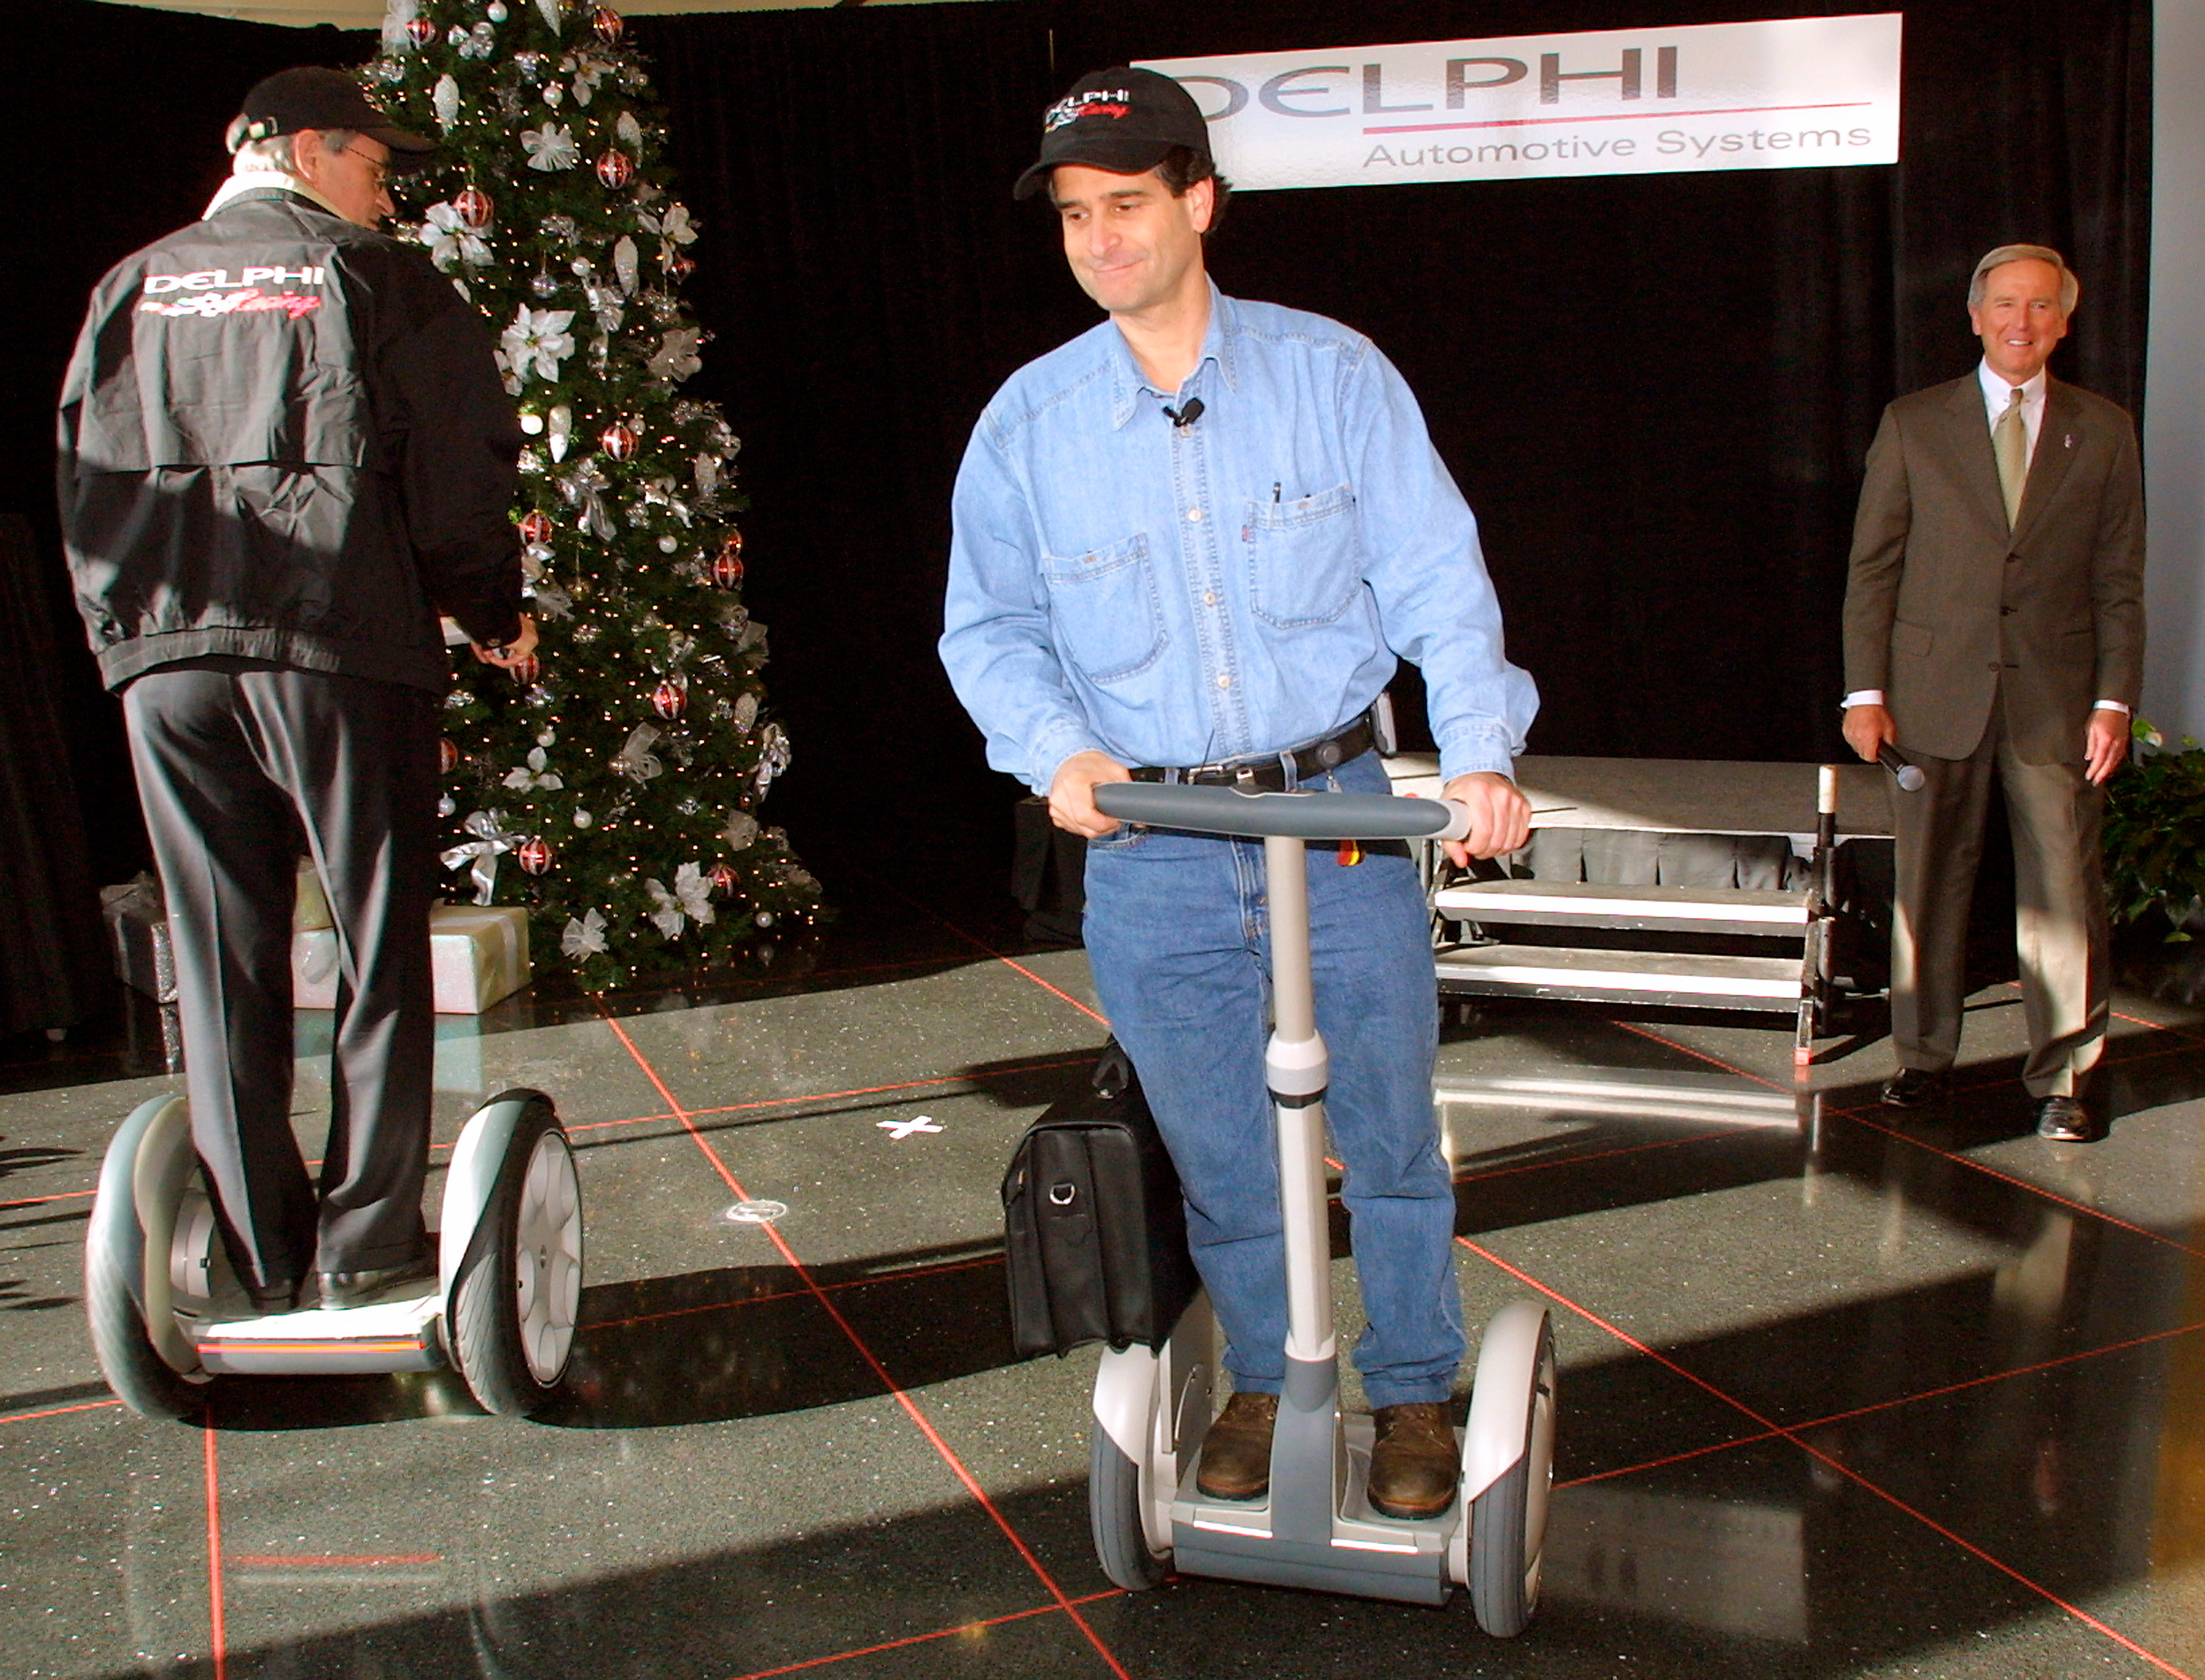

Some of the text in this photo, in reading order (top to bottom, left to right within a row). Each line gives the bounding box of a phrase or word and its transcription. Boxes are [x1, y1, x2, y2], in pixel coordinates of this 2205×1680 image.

[1176, 46, 1678, 123] DELPHI
[1363, 127, 1872, 168] Automotive Systems
[144, 266, 324, 294] DELPHI
